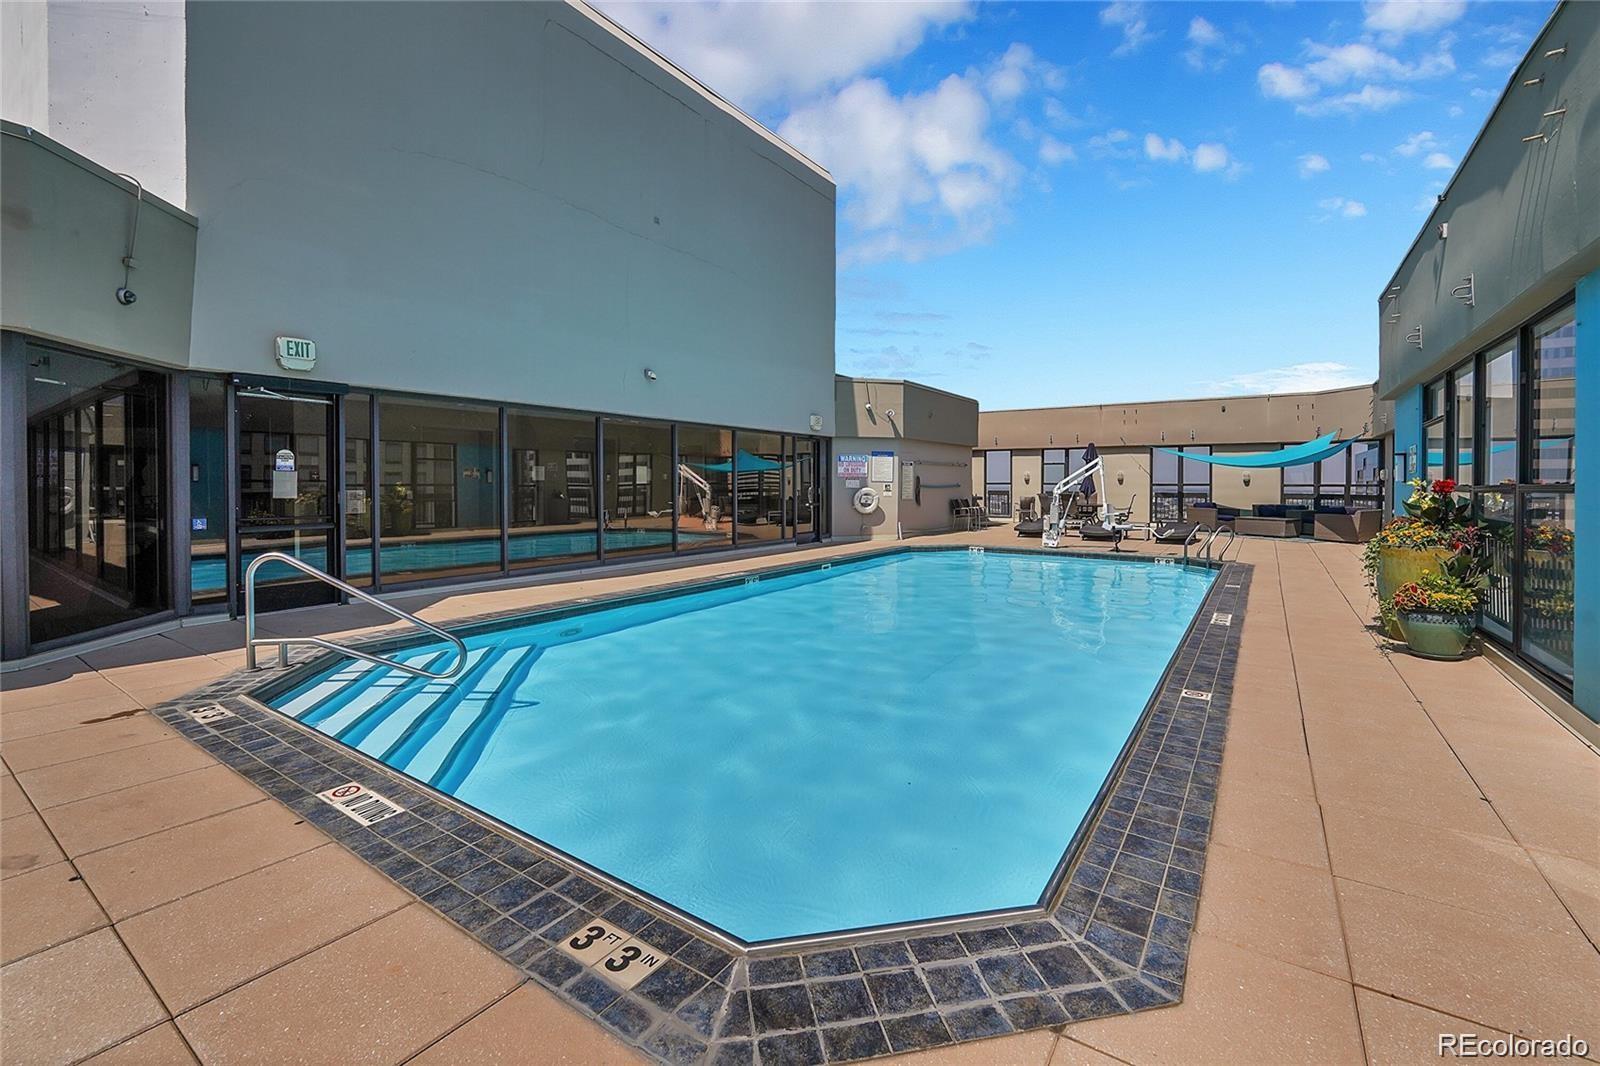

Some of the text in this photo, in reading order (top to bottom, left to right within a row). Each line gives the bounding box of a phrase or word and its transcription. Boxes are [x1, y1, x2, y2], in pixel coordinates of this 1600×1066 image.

[287, 341, 310, 358] EXIT
[569, 926, 622, 950] 3 FT
[605, 946, 660, 972] 3 IN
